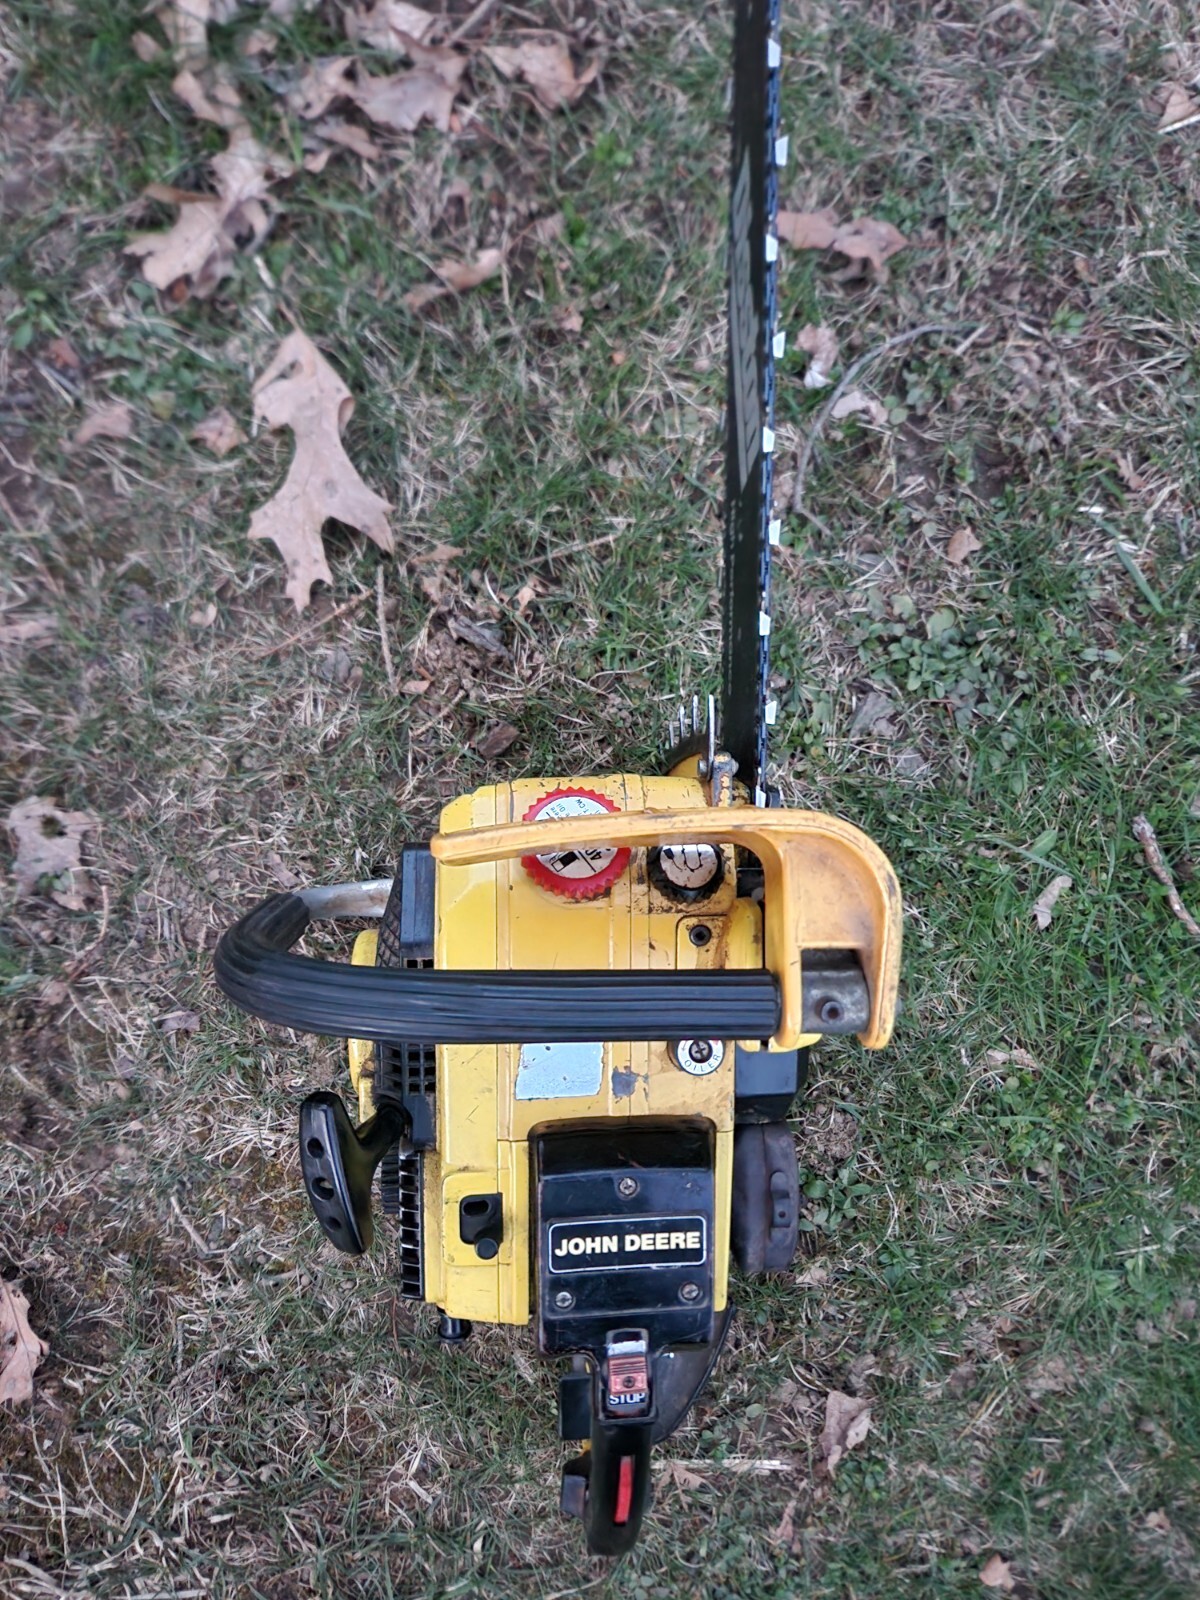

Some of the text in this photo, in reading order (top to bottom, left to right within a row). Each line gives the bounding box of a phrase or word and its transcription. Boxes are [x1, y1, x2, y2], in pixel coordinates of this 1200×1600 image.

[684, 1054, 721, 1072] OILER
[554, 1231, 701, 1257] JOHN DEERE
[609, 1392, 646, 1405] STOP
